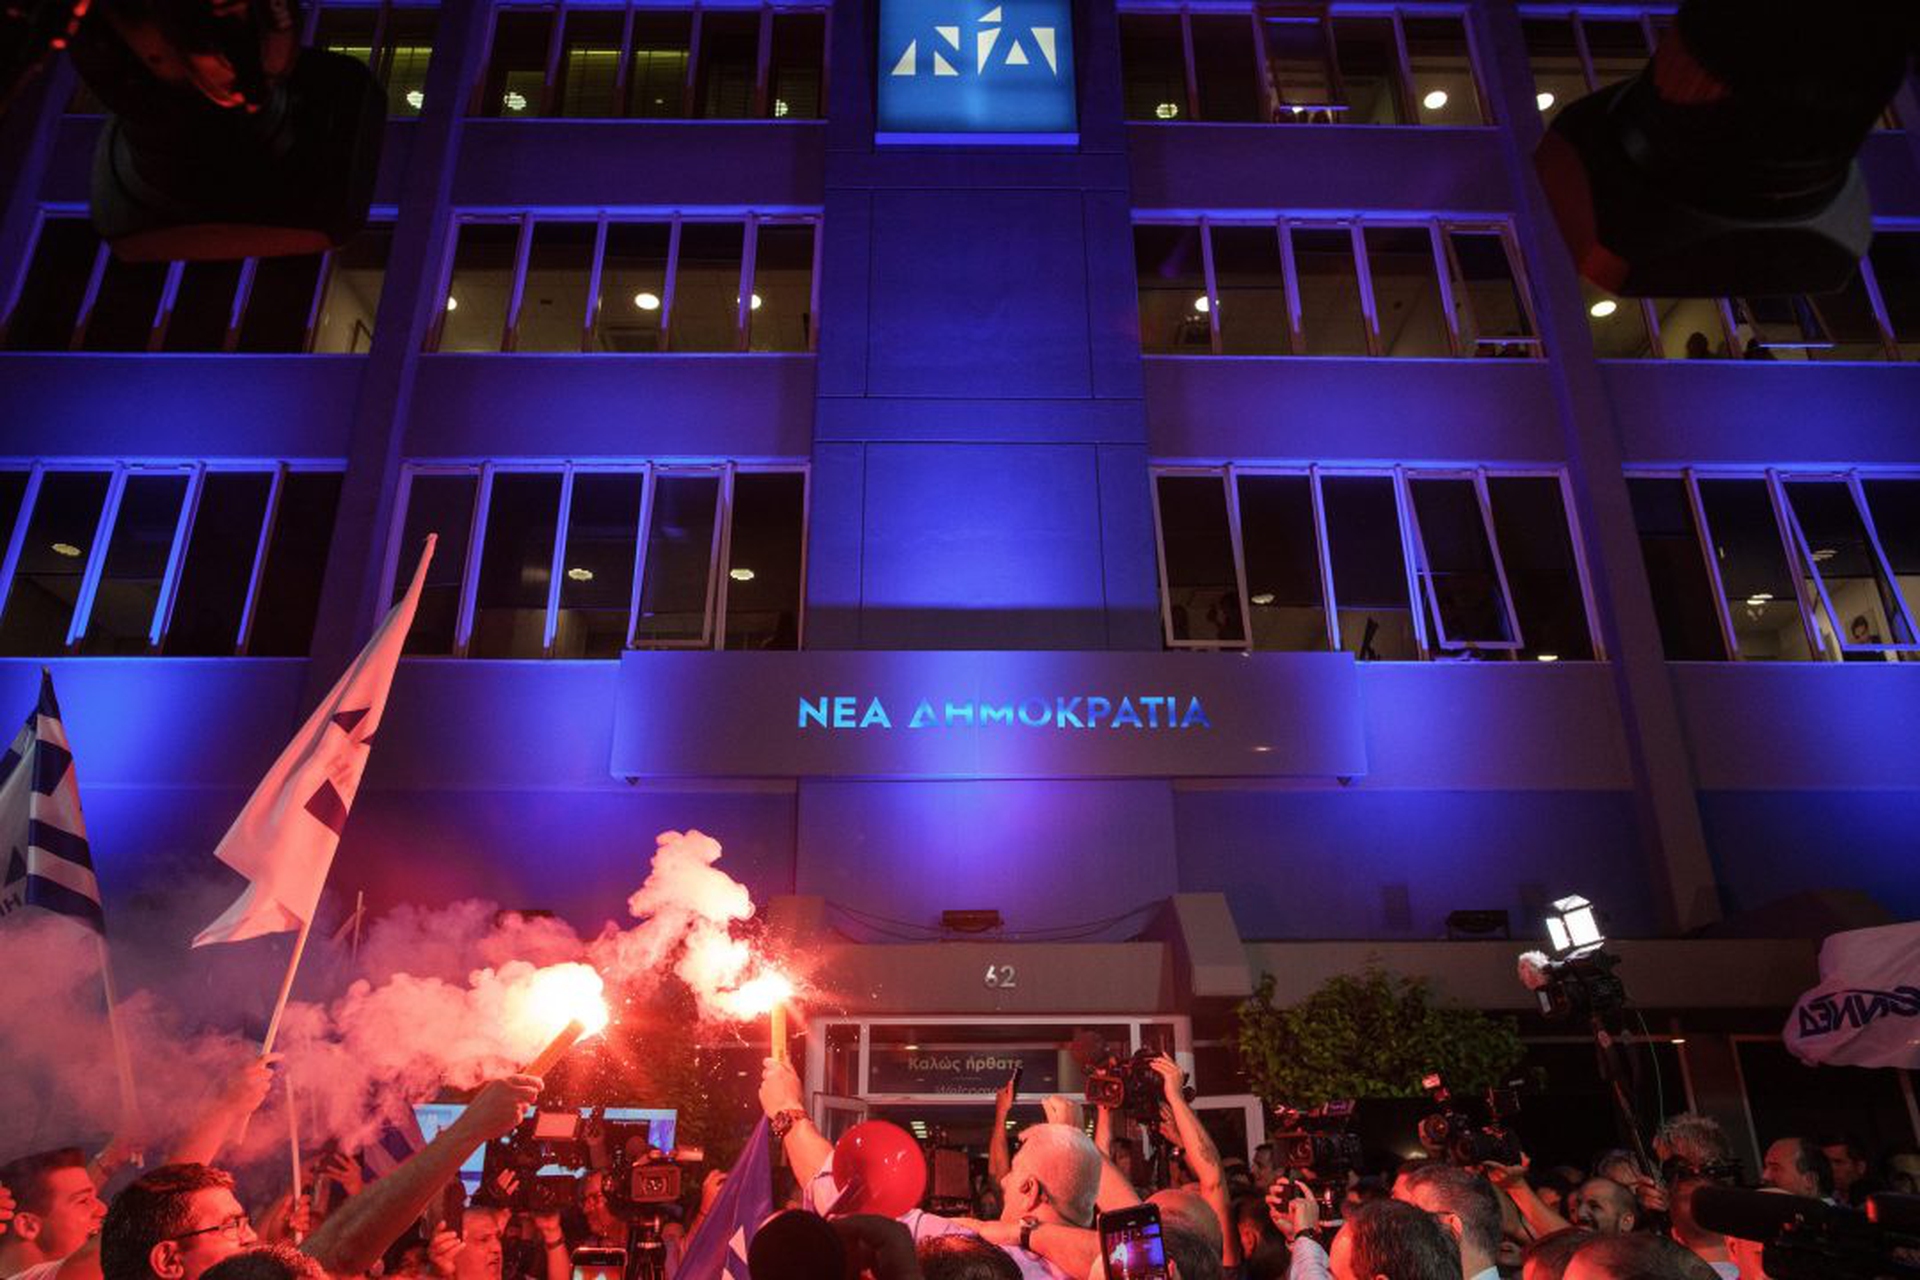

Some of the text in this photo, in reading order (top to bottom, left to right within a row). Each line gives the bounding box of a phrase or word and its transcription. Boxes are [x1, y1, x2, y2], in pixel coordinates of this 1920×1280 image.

[798, 696, 1211, 728] ΝΕΑ ΔΗΜΟΚΡΑΤΙΑ
[984, 965, 1017, 988] 62
[909, 1055, 1024, 1073] Καλώς ήρθατε
